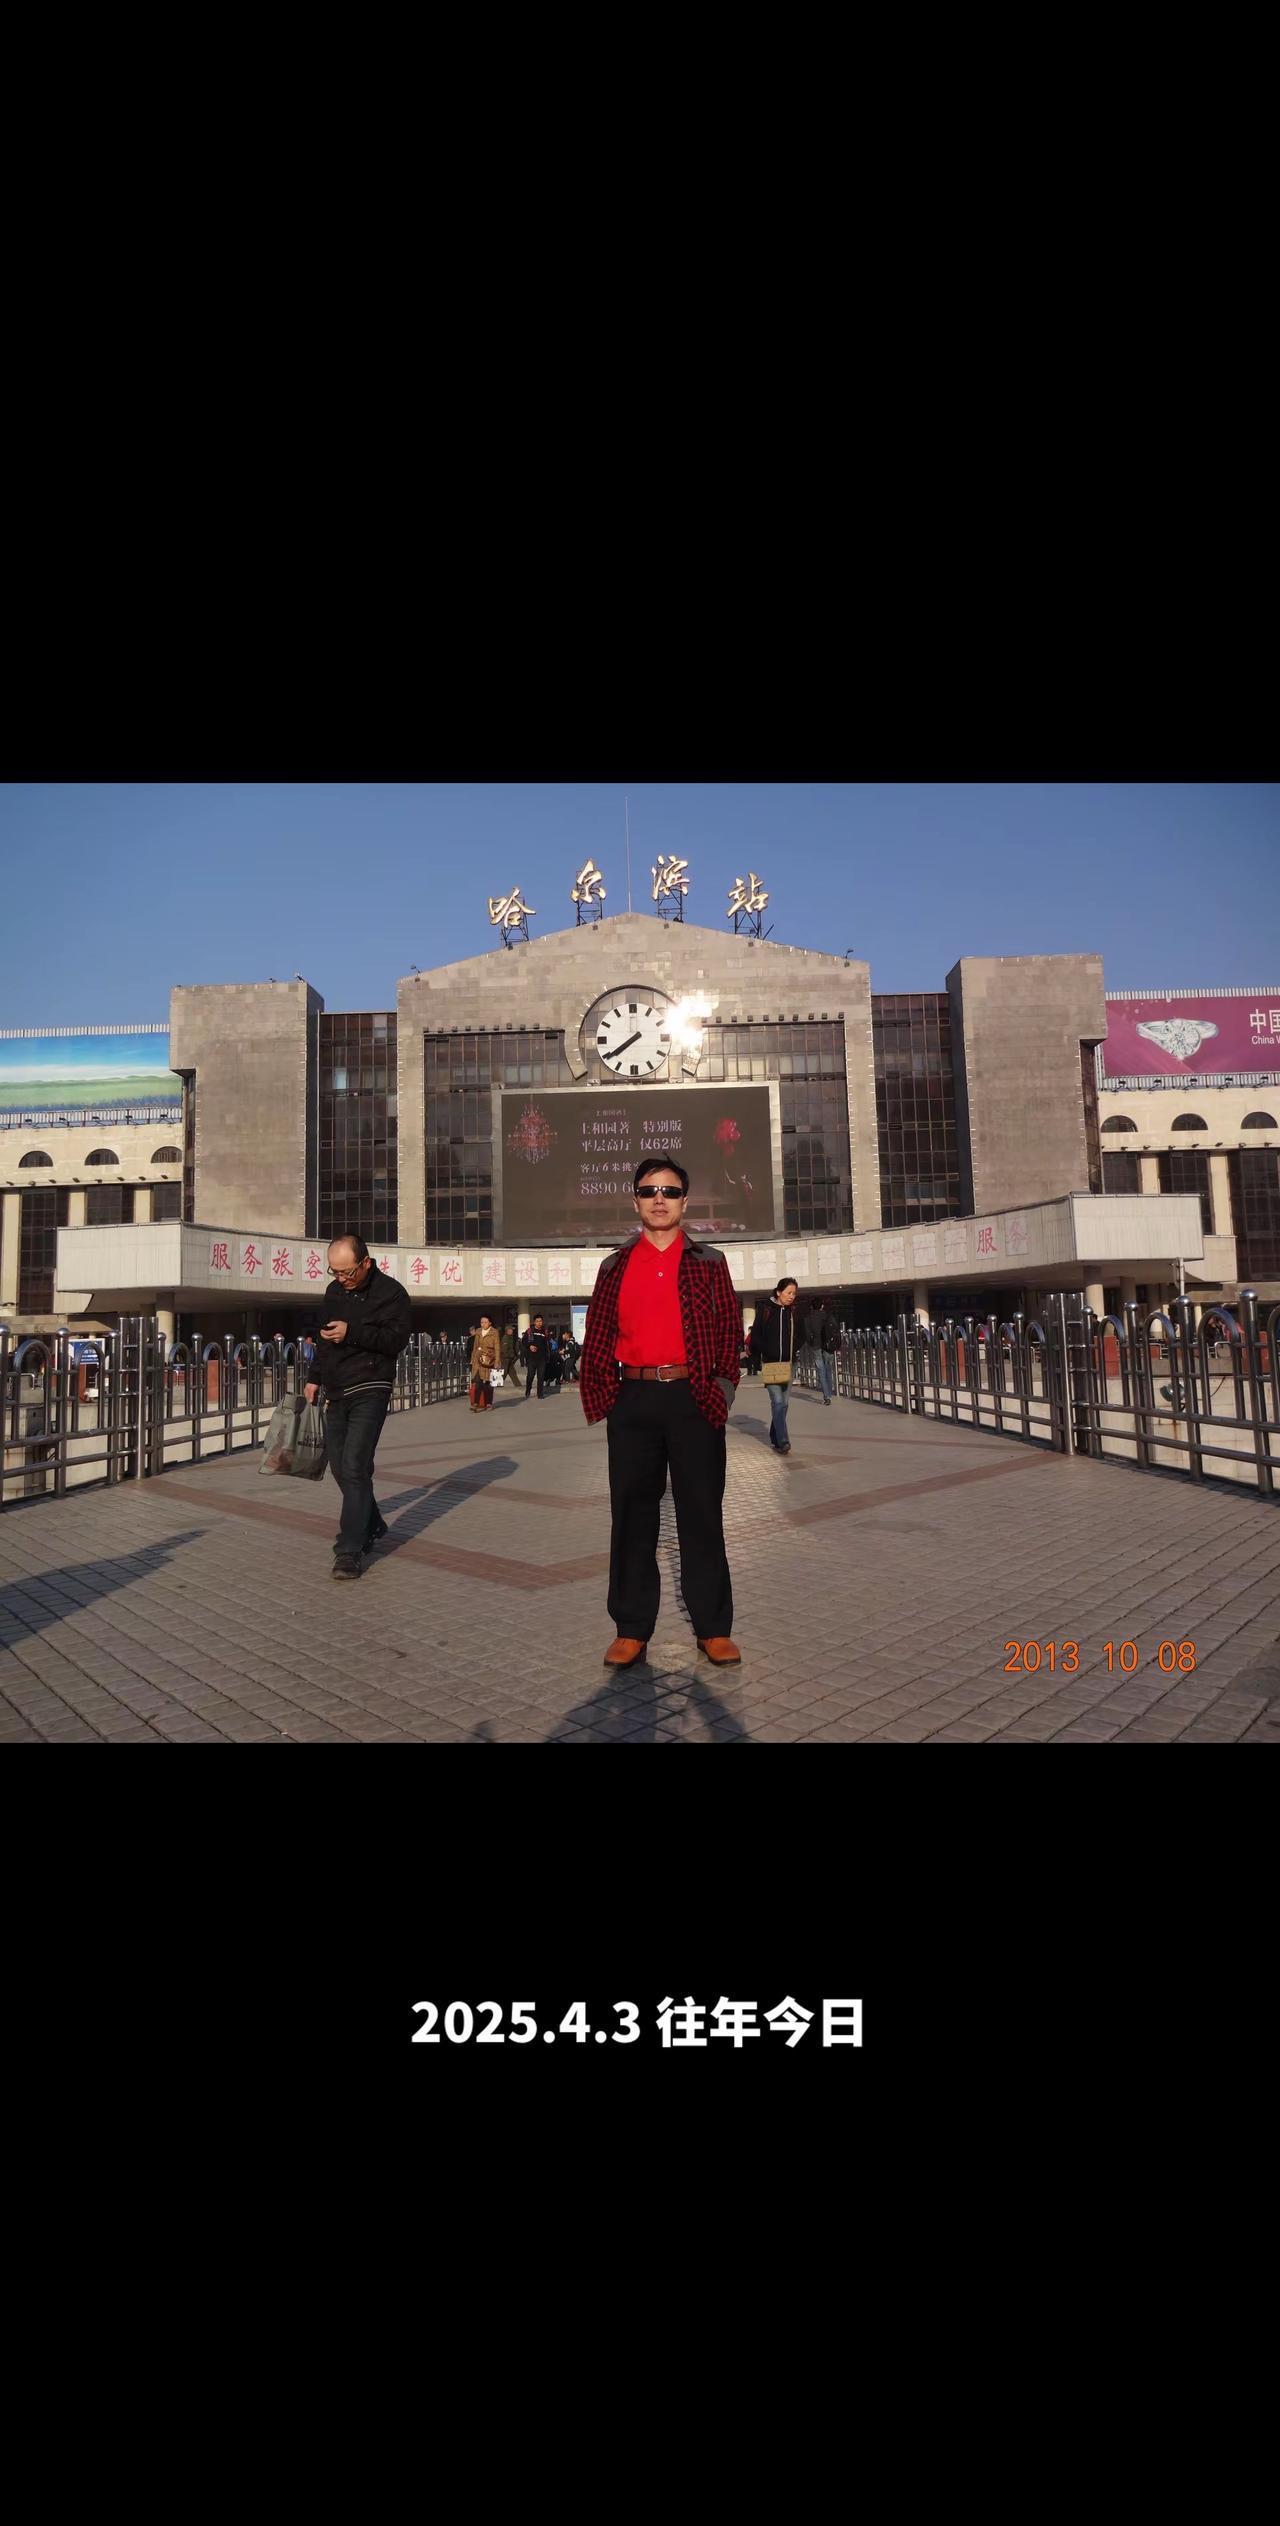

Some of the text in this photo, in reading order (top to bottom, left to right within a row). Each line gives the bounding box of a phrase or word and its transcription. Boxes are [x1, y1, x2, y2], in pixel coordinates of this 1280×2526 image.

[488, 855, 769, 928] 哈尔滨站
[1251, 1035, 1275, 1045] China
[642, 1119, 682, 1133] 特别版
[640, 1136, 682, 1150] 仅62席
[580, 1181, 617, 1195] 8890
[210, 1243, 324, 1280] 服务旅客
